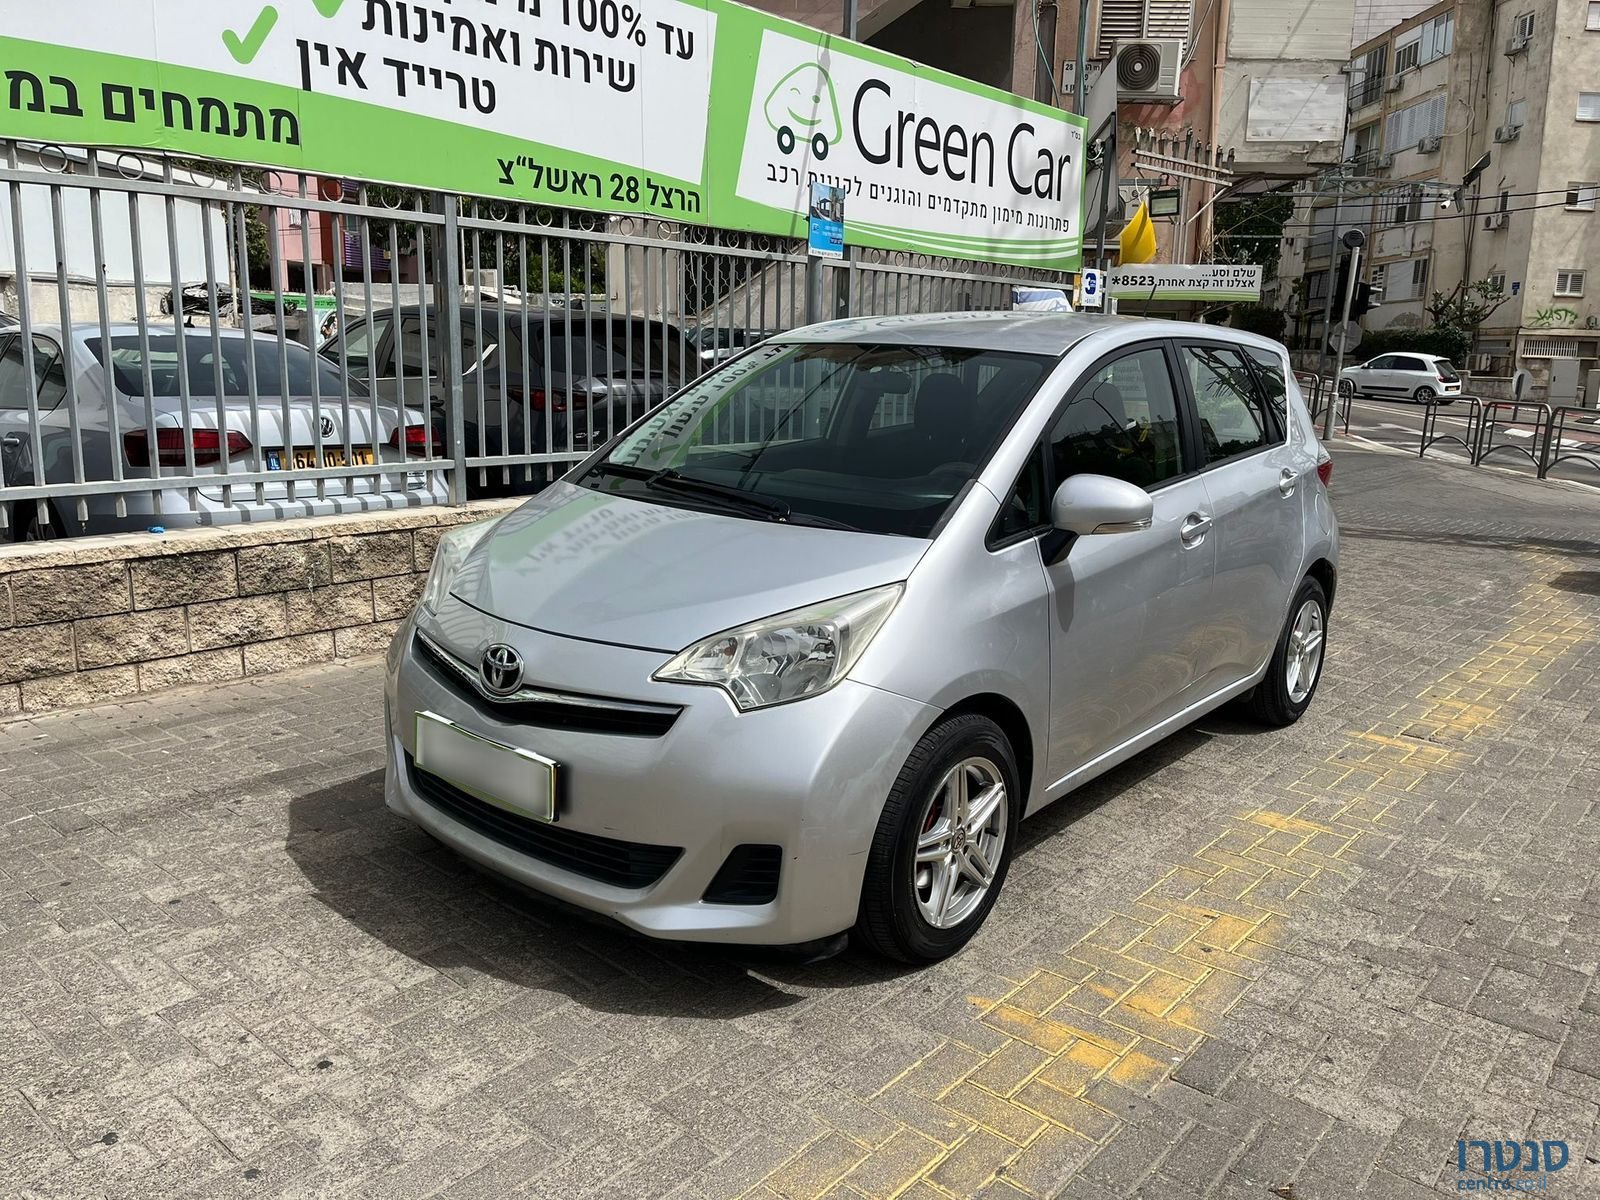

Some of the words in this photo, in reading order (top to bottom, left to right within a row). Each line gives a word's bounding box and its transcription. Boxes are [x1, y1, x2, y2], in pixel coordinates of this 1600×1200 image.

[361, 0, 521, 66] ואמינות
[656, 21, 694, 60] עד
[296, 38, 368, 92] אין
[534, 37, 636, 93] שירות
[383, 56, 497, 115] טרייד
[101, 81, 300, 146] מתמחים
[852, 78, 995, 188] Green
[1007, 122, 1071, 202] Car
[610, 173, 640, 203] 28
[767, 163, 799, 186] רכב
[646, 177, 701, 213] הרצל
[870, 183, 922, 208] והוגנים
[928, 194, 988, 220] מתקדמים
[992, 205, 1023, 225] מימון
[1027, 212, 1070, 232] פתרונות
[1188, 279, 1210, 290] קצת
[1212, 279, 1225, 288] זה
[1226, 277, 1255, 288] אצלנו
[1233, 267, 1256, 278] שלם
